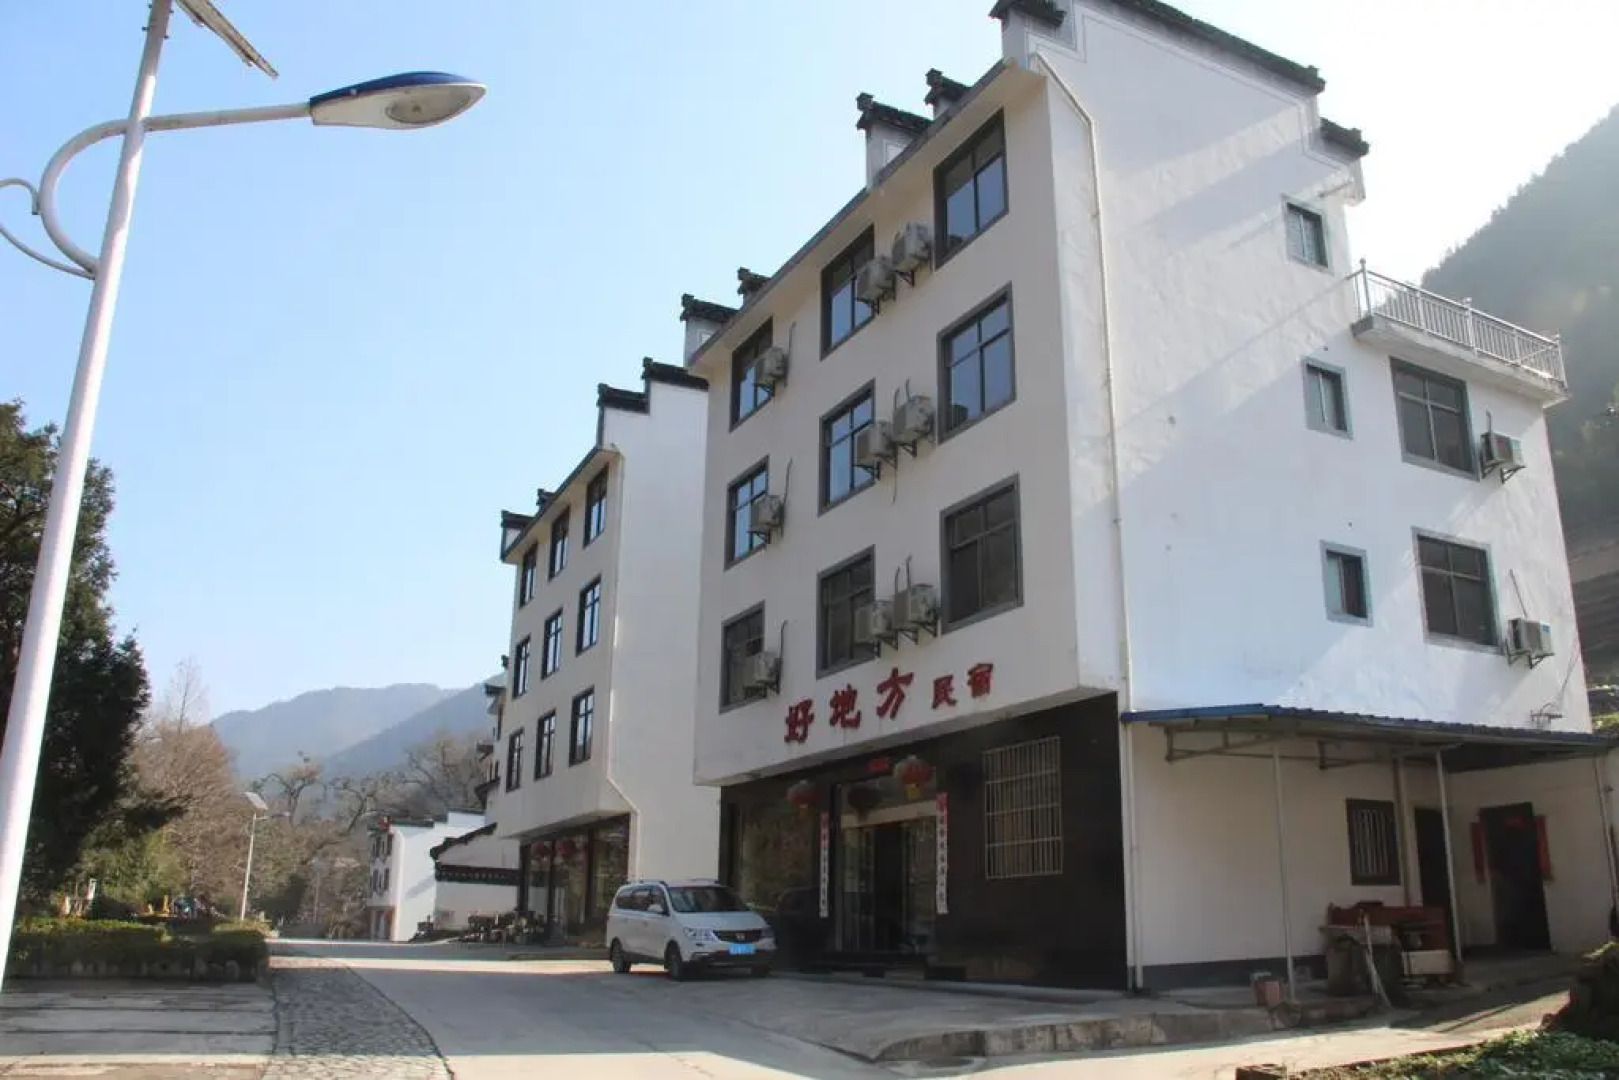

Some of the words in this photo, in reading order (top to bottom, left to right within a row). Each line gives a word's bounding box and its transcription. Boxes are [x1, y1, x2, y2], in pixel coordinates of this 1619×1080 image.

[784, 663, 994, 743] 好地方民宿
